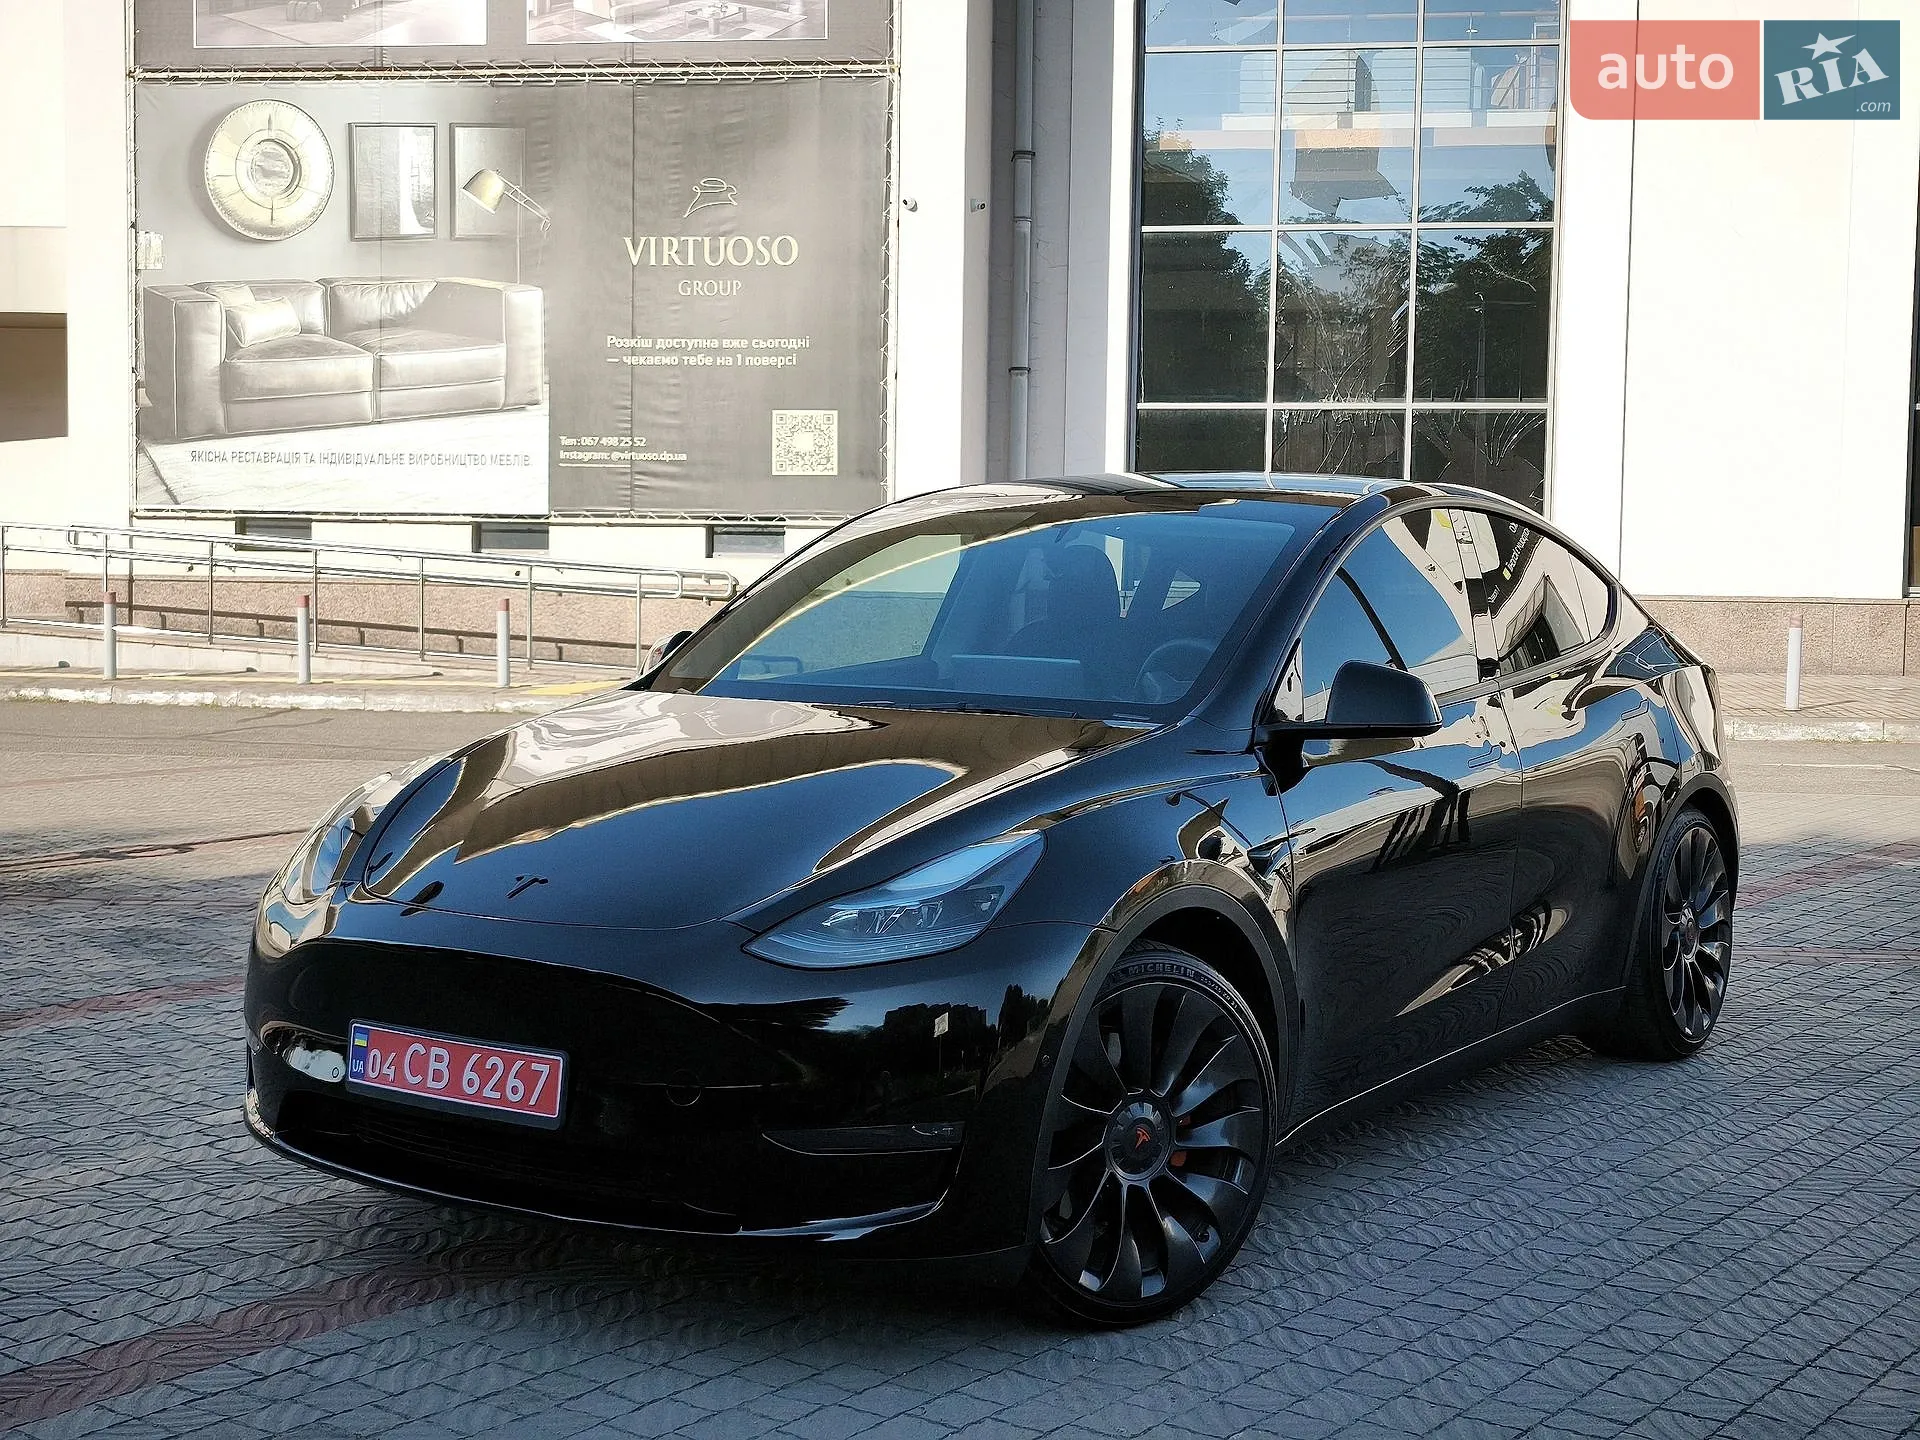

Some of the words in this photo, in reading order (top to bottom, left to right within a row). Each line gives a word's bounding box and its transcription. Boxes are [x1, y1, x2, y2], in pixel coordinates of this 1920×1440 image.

[623, 235, 799, 267] VIRTUOSO
[678, 279, 742, 297] GROUP
[606, 335, 653, 349] Розкіш
[655, 338, 719, 351] доступна
[722, 338, 749, 349] вже
[751, 335, 810, 350] сьогодні
[622, 355, 679, 366] чекаємо
[682, 353, 713, 366] тебе
[716, 355, 733, 366] на
[736, 353, 742, 366] 1
[745, 353, 797, 369] поверсі
[619, 436, 633, 447] 25
[633, 437, 647, 447] 52
[190, 450, 229, 463] ЯКІСНА
[231, 451, 301, 466] РЕСТАВРАЦІЯ
[303, 452, 317, 464] ТА
[319, 452, 405, 467] ІНДИВІДУАЛЬНЕ
[408, 453, 487, 468] ВИРОБНИЦТВО
[559, 450, 610, 462] Instagram:
[610, 450, 688, 463] @virtuoso.dp.ua
[1128, 963, 1195, 979] MICHELIN
[352, 1059, 364, 1075] UA
[368, 1048, 397, 1082] 04
[403, 1042, 450, 1090] CB
[462, 1053, 550, 1106] 6267
